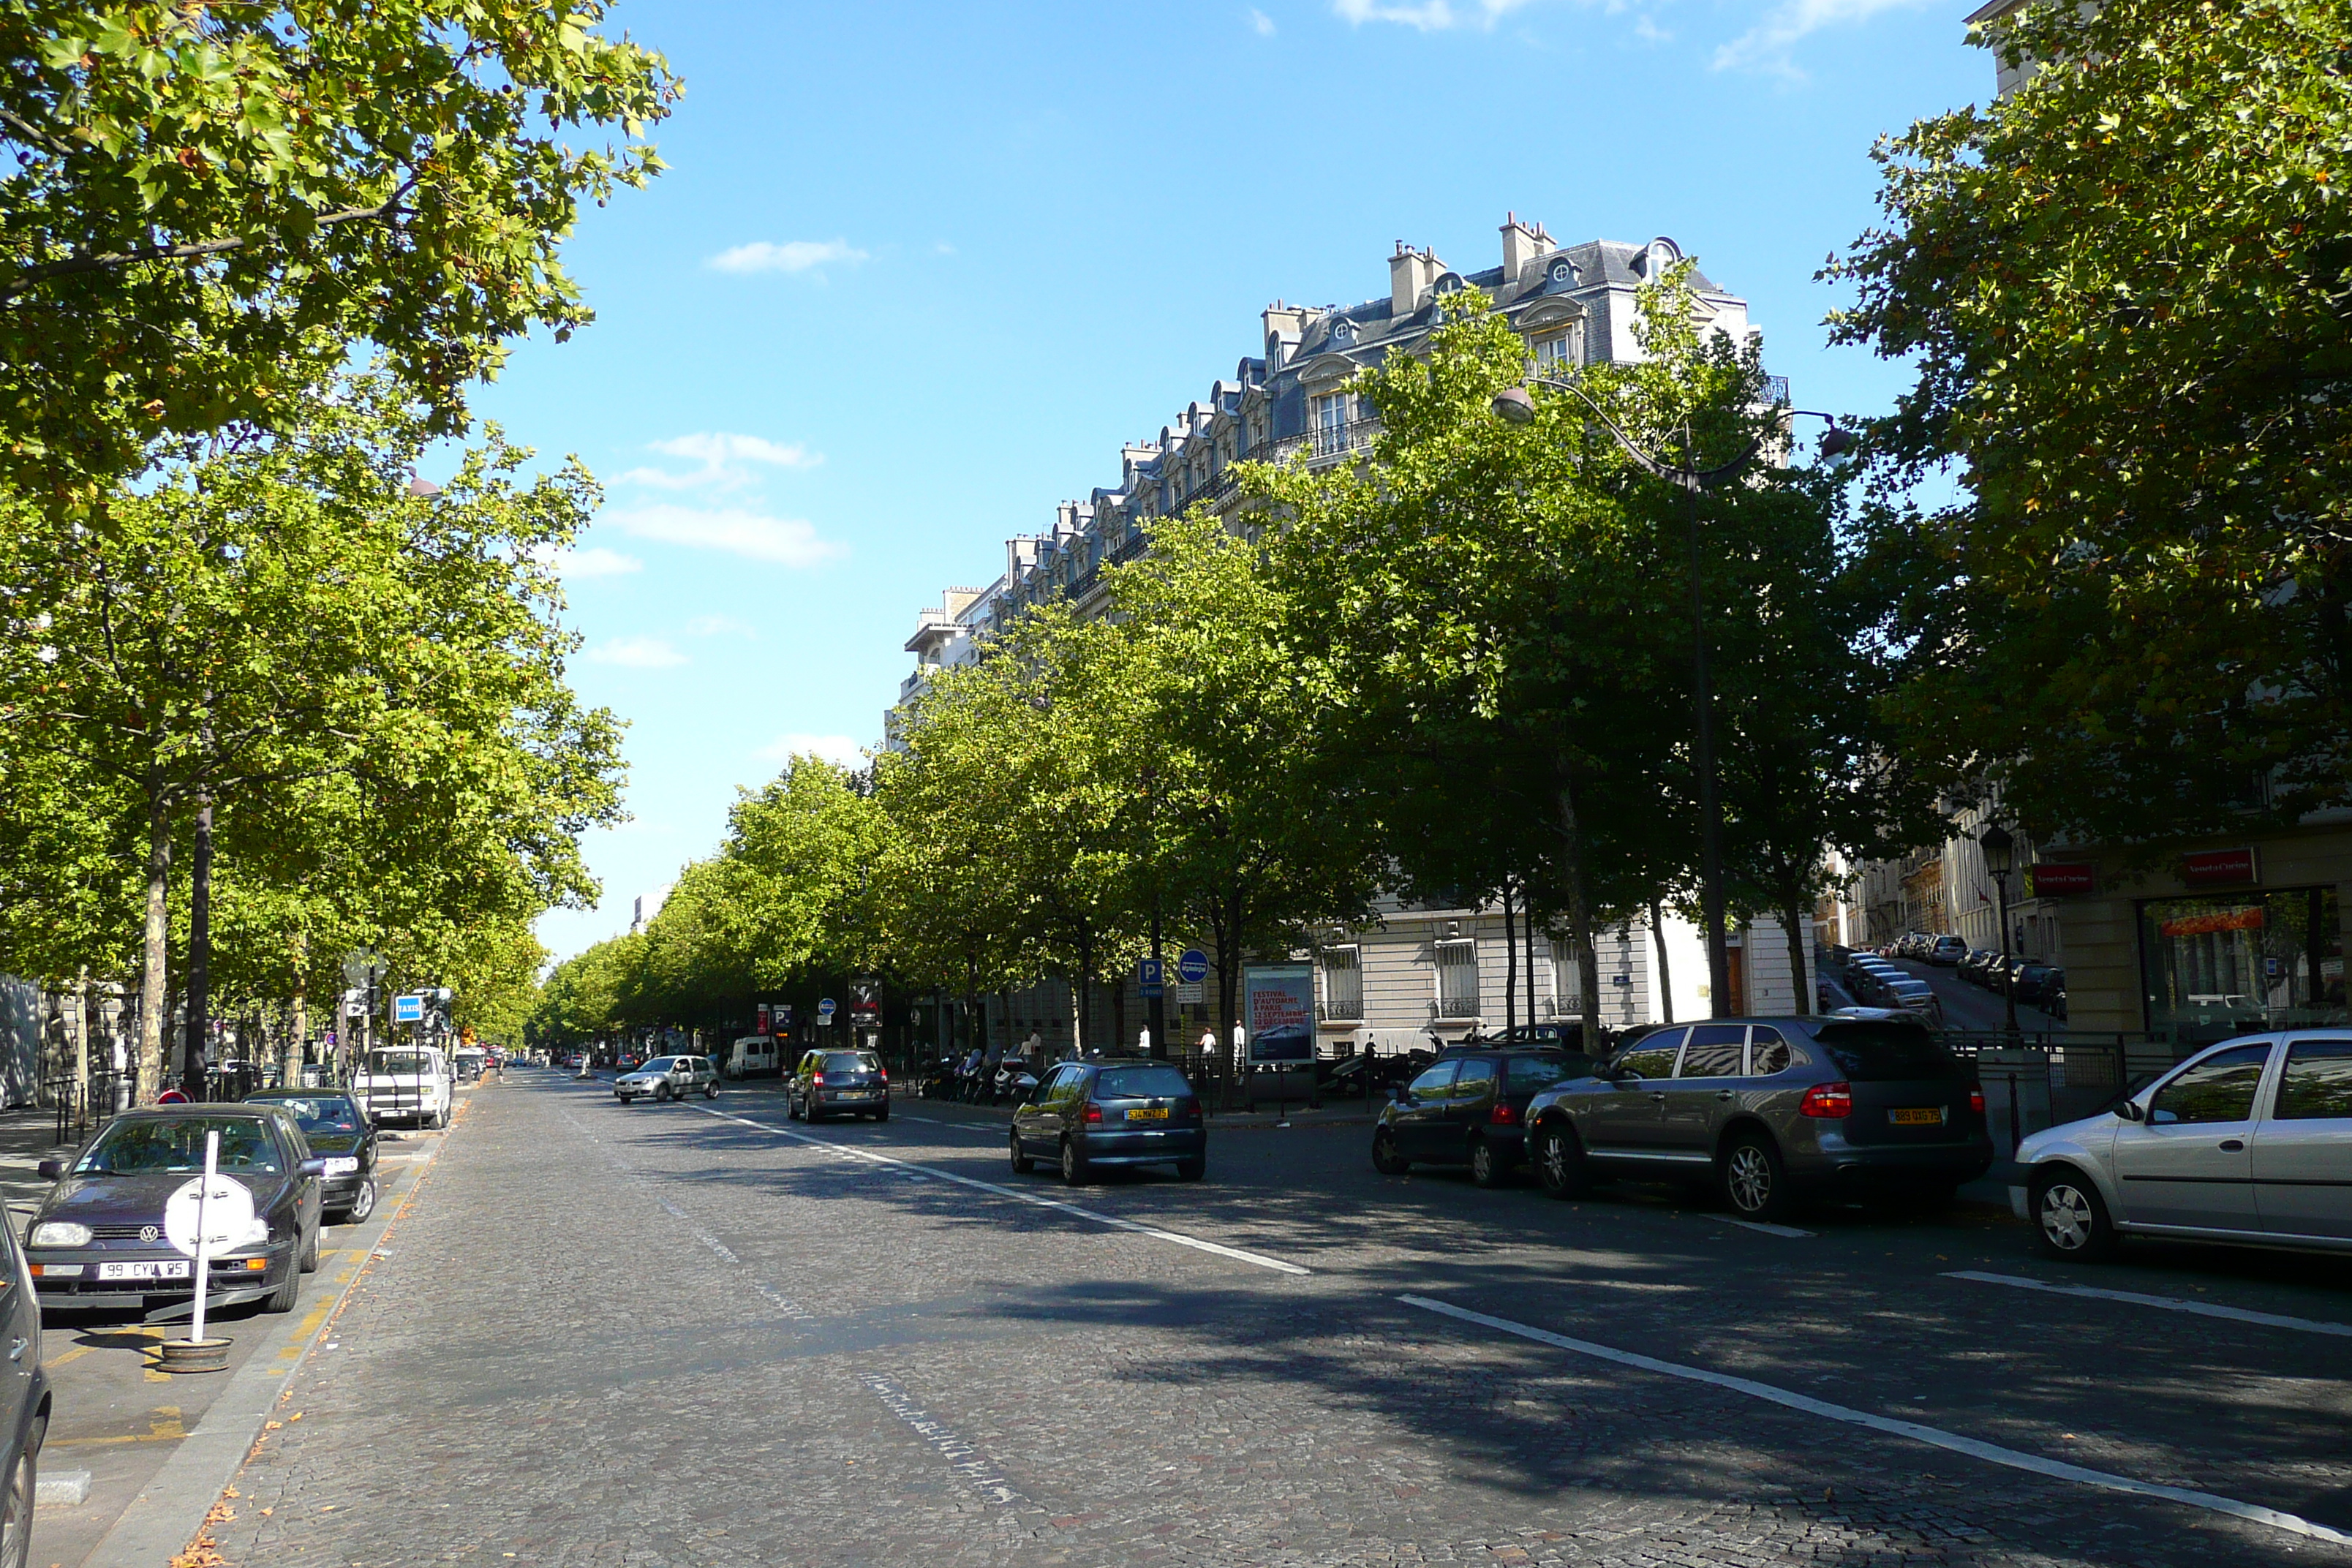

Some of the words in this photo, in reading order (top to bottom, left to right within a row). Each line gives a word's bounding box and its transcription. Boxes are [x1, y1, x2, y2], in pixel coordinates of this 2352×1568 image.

[1145, 964, 1156, 979] P
[1254, 997, 1298, 1005] D'AUTOMNE
[398, 1004, 420, 1013] TAXIS
[775, 1011, 785, 1023] P
[1128, 1110, 1142, 1119] 534
[1157, 1109, 1167, 1117] 75
[1896, 1111, 1911, 1121] 889
[1929, 1110, 1940, 1120] 75
[108, 1264, 123, 1277] 99
